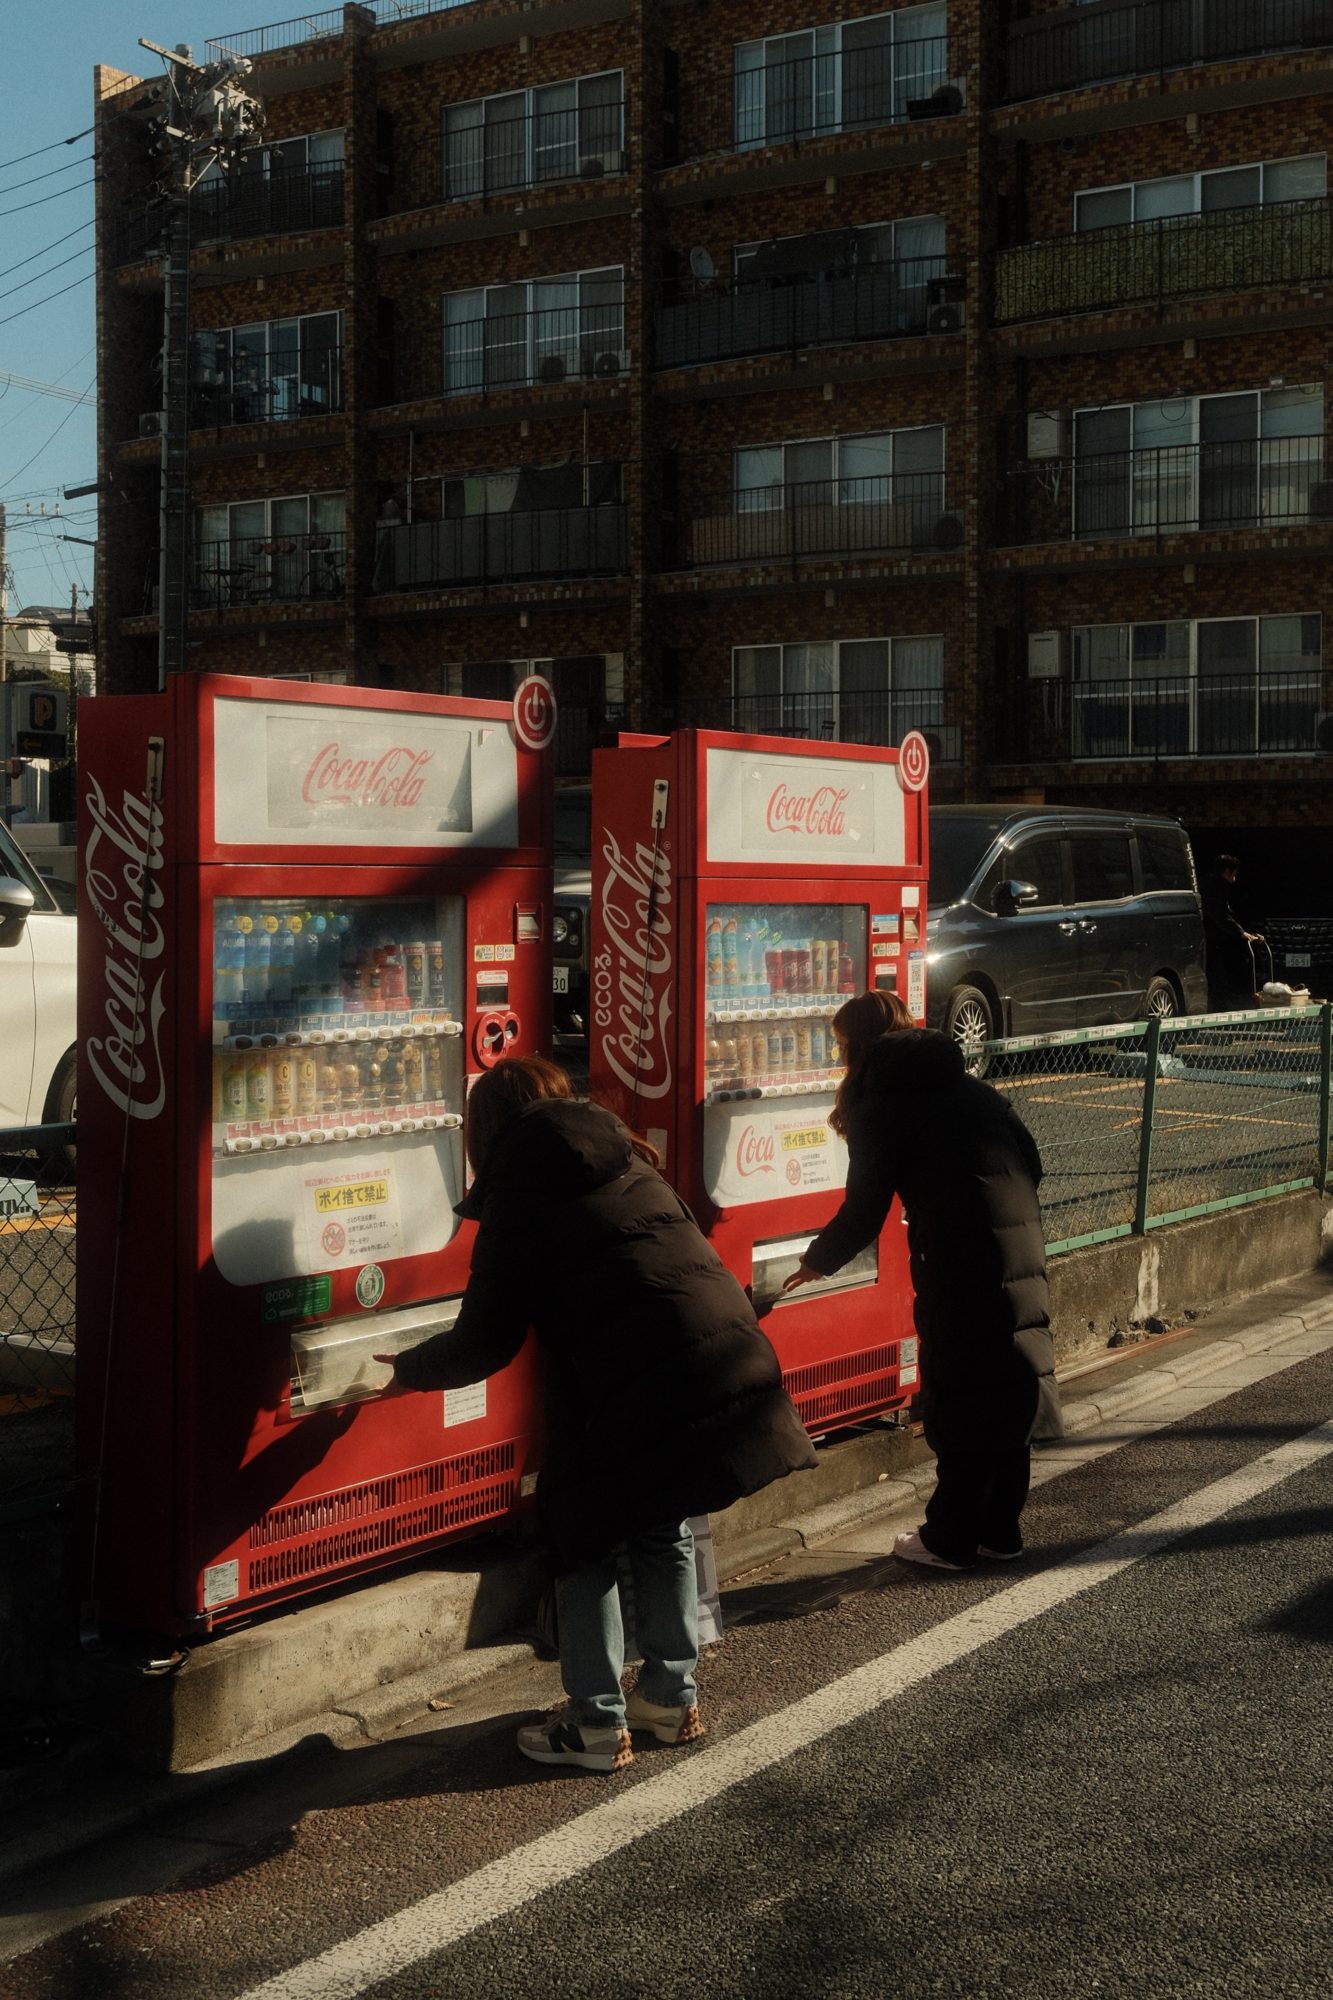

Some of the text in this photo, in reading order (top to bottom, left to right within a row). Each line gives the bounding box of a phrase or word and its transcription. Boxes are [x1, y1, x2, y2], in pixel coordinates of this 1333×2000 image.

[302, 742, 435, 808] Coca-Cola
[766, 783, 849, 835] Coca-Cola
[86, 771, 166, 1121] Coca-Cola
[602, 826, 673, 1100] Coca-Cola
[319, 1183, 386, 1209] ポイ捨て禁止
